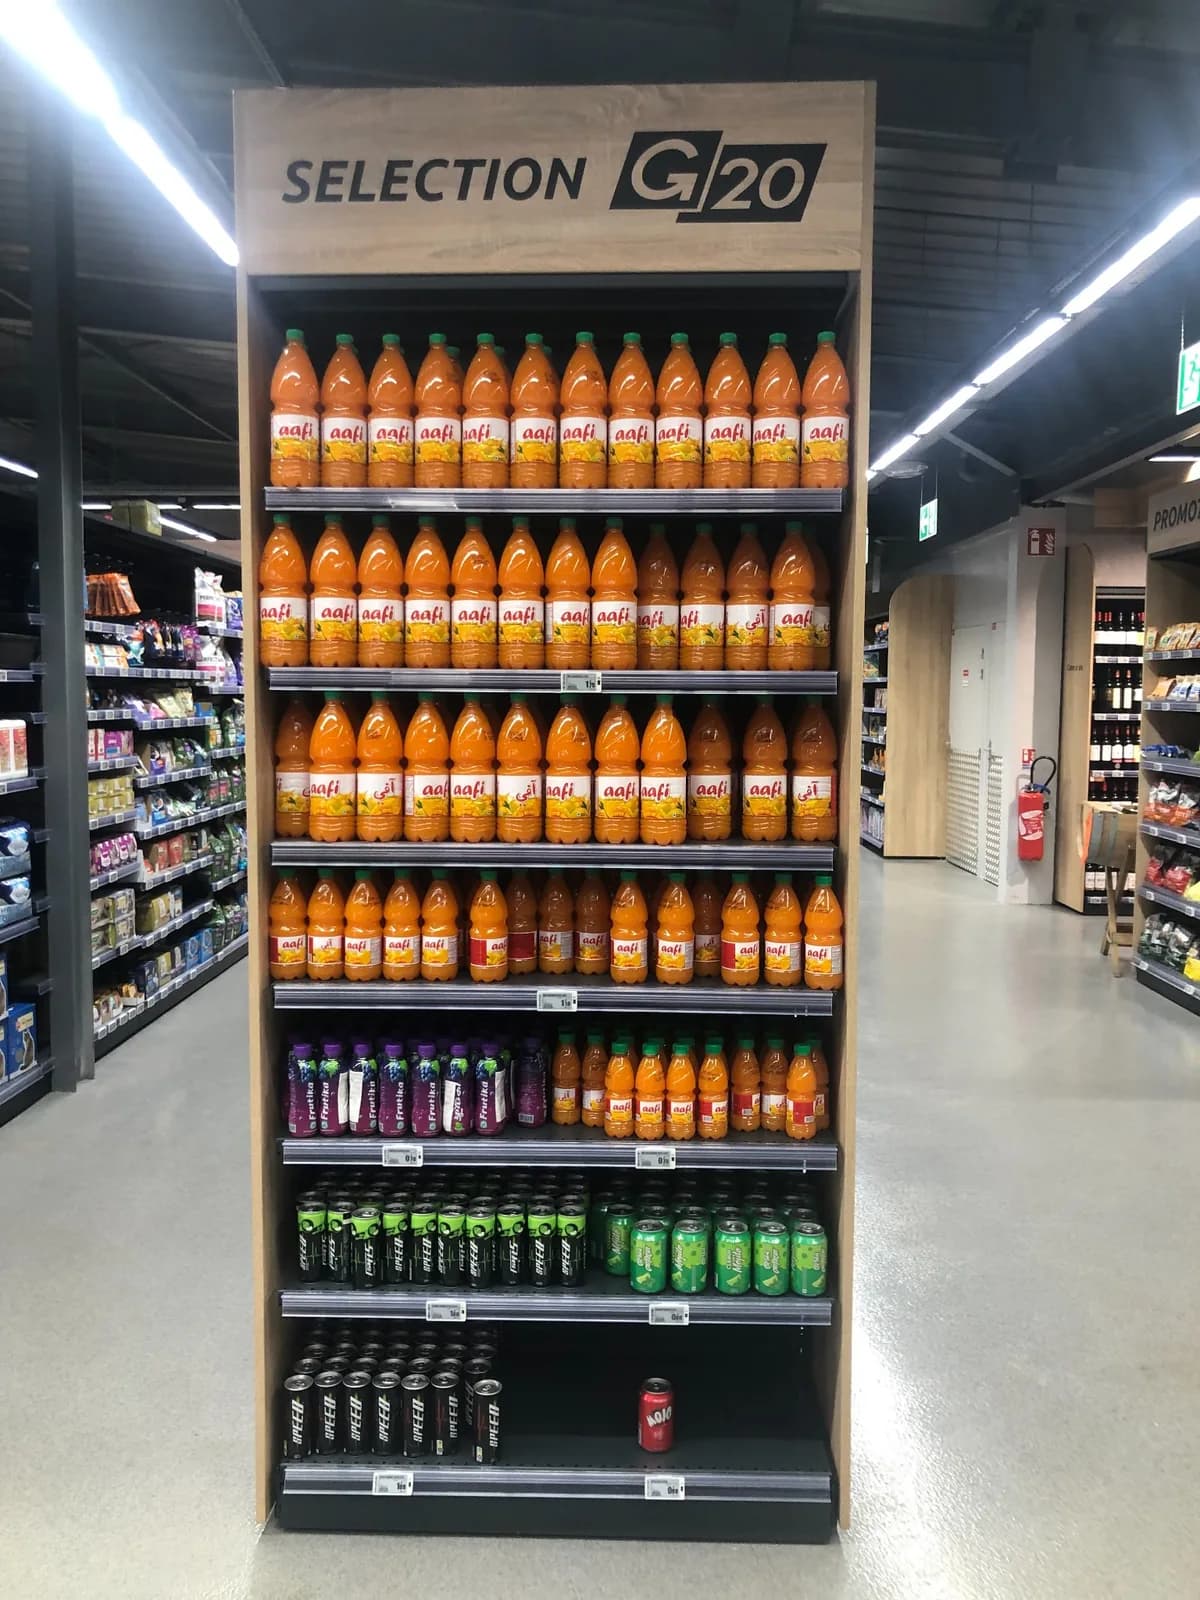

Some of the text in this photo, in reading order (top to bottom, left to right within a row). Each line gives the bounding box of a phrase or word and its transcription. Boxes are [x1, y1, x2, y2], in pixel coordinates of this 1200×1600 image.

[282, 157, 587, 204] SELECTION
[278, 423, 312, 440] aafi
[330, 425, 363, 444] aafi
[376, 424, 409, 444] aafi
[420, 424, 454, 444] aafi
[522, 424, 554, 442] aafi
[563, 423, 596, 442] aafi
[615, 425, 648, 444] aafi
[658, 424, 690, 442] aafi
[711, 424, 745, 443] aafi
[754, 424, 786, 442] aafi
[809, 424, 844, 442] aafi
[1153, 498, 1200, 533] PROMO
[261, 604, 292, 622] aafi
[321, 604, 354, 623] aafi
[362, 605, 394, 624] aafi
[410, 606, 443, 625] aafi
[458, 606, 491, 624] aafi
[503, 606, 536, 624] aafi
[597, 608, 629, 625] aafi
[680, 610, 698, 628] afi
[781, 608, 813, 628] aafi
[310, 780, 339, 798] aafi
[422, 780, 449, 799] aaf
[454, 781, 485, 799] aafi
[604, 782, 636, 800] aafi
[641, 784, 670, 801] aafi
[696, 780, 728, 798] aafi
[750, 782, 782, 800] aafi
[282, 938, 304, 950] aafi
[346, 940, 367, 952] aafi
[388, 940, 410, 952] aafi
[424, 940, 444, 952] aafi
[582, 934, 604, 946] aafi
[617, 942, 638, 955] aafi
[661, 942, 682, 955] aafi
[740, 943, 759, 956] aafi
[766, 943, 786, 956] aafi
[808, 947, 828, 960] aafi
[306, 1082, 316, 1120] Frutika
[320, 1082, 330, 1120] Frutika
[368, 1080, 376, 1119] Frutika
[396, 1082, 404, 1120] Frutika
[428, 1082, 436, 1120] Frutika
[480, 1081, 488, 1120] Frutika
[612, 1100, 630, 1112] aafi
[642, 1104, 661, 1114] aafi
[673, 1104, 692, 1114] aafi
[394, 1236, 403, 1272] SPEED
[422, 1236, 432, 1272] SPEED
[470, 1240, 478, 1277] SPEED
[535, 1240, 544, 1276] SPEED
[562, 1239, 571, 1276] SPEED
[291, 1400, 304, 1444] SPEED
[324, 1395, 336, 1440] SPEED
[350, 1395, 362, 1441] SPEED
[378, 1396, 390, 1442] SPEED
[412, 1398, 425, 1442] SPEED
[448, 1395, 458, 1438] SPEED
[489, 1403, 500, 1448] SPEED
[646, 1406, 672, 1428] MOJO
